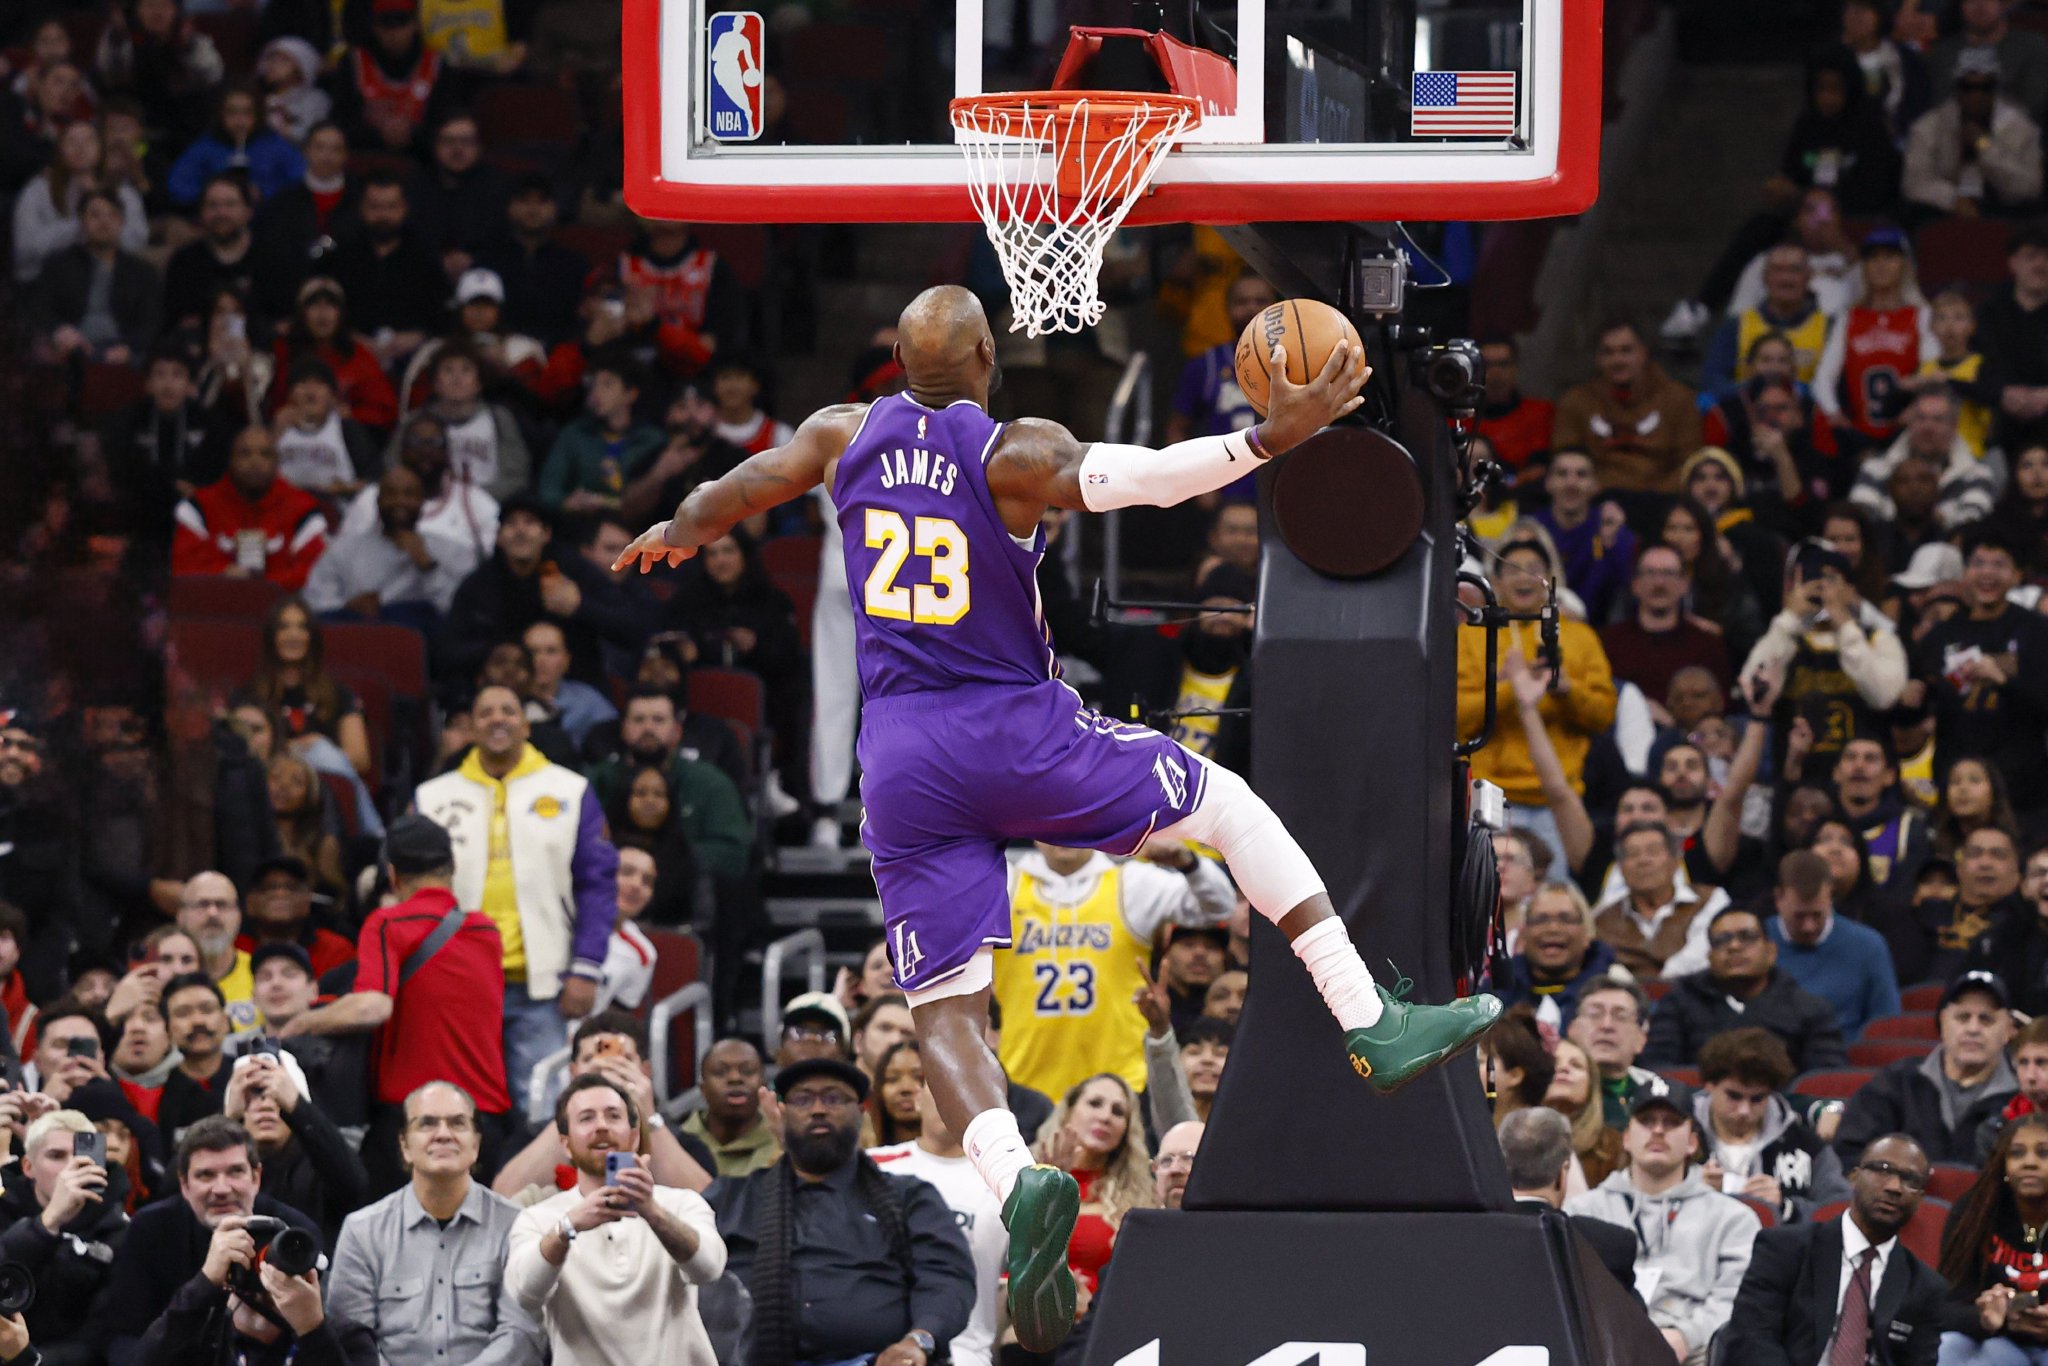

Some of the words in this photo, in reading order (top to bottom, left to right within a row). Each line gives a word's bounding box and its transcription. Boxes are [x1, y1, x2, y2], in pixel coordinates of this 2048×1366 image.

[716, 111, 742, 131] NBA
[880, 448, 958, 496] JAMES
[864, 507, 971, 626] 23
[893, 919, 926, 984] LA
[1034, 961, 1098, 1017] 23
